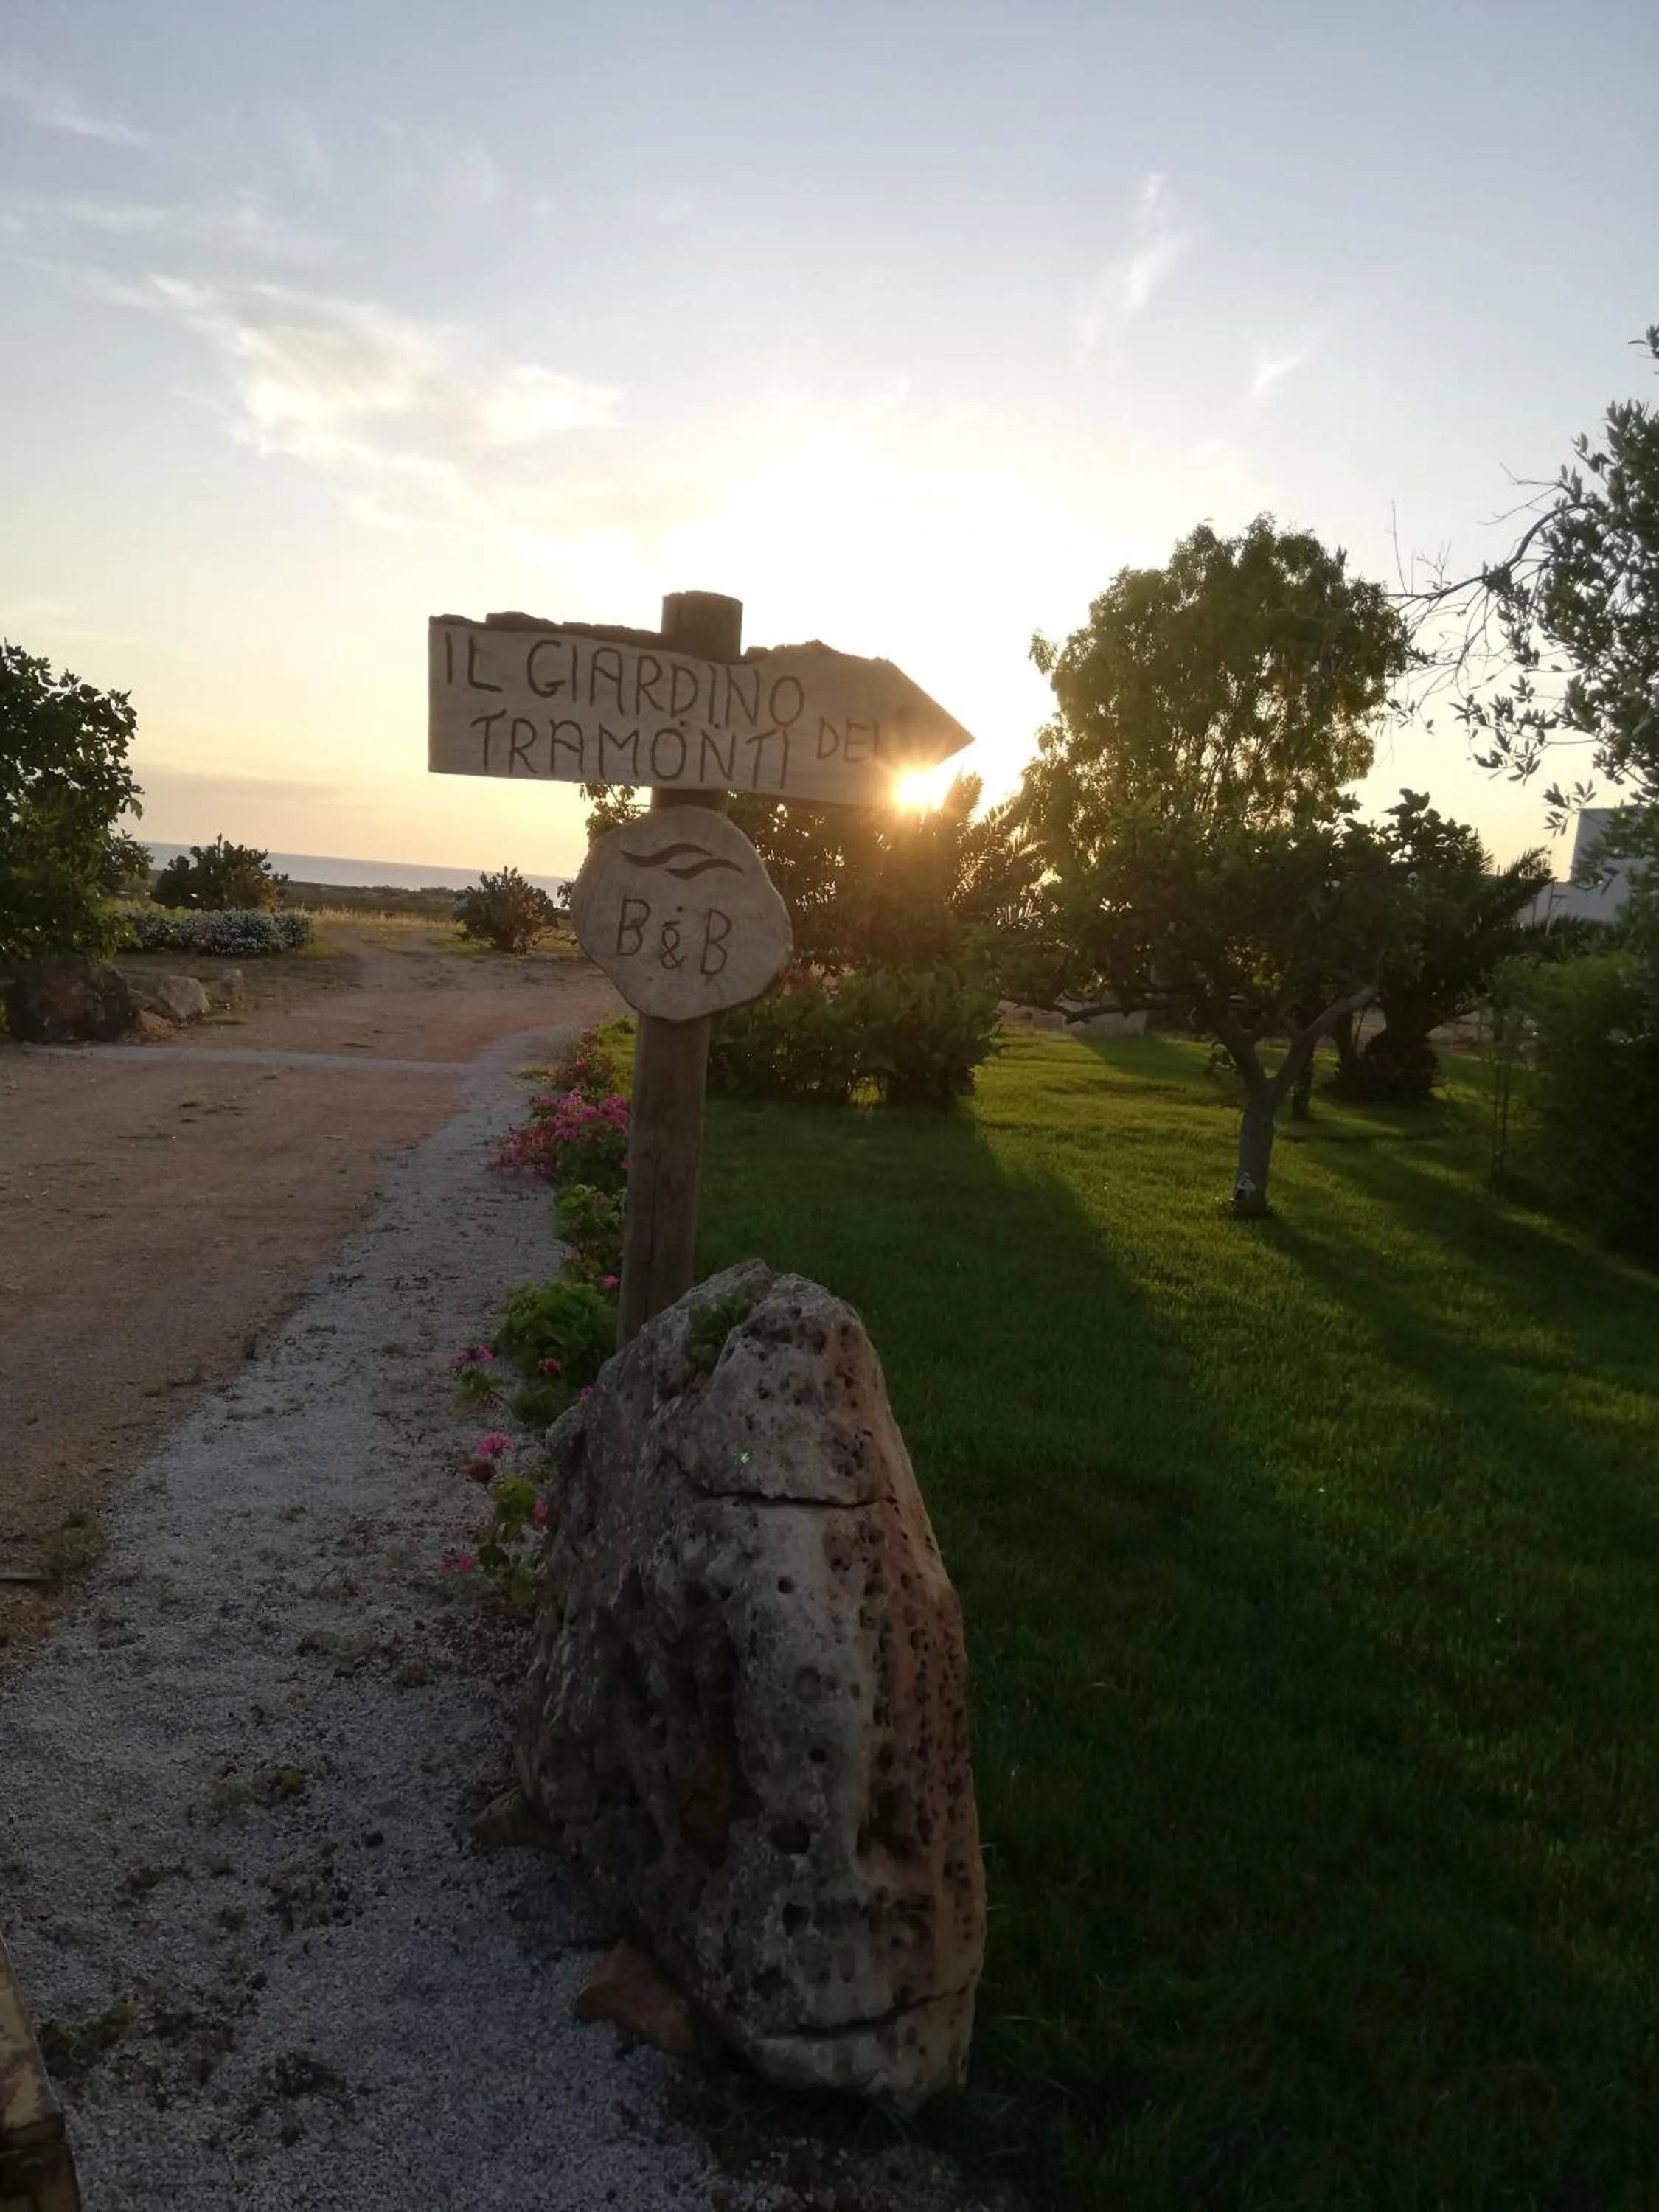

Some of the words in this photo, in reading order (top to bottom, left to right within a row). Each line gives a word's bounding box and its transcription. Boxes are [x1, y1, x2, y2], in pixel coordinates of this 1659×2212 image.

[445, 630, 503, 692] IL
[526, 639, 804, 728] GIARDINO
[470, 708, 790, 790] TRAMONTI
[815, 715, 880, 763] DEI
